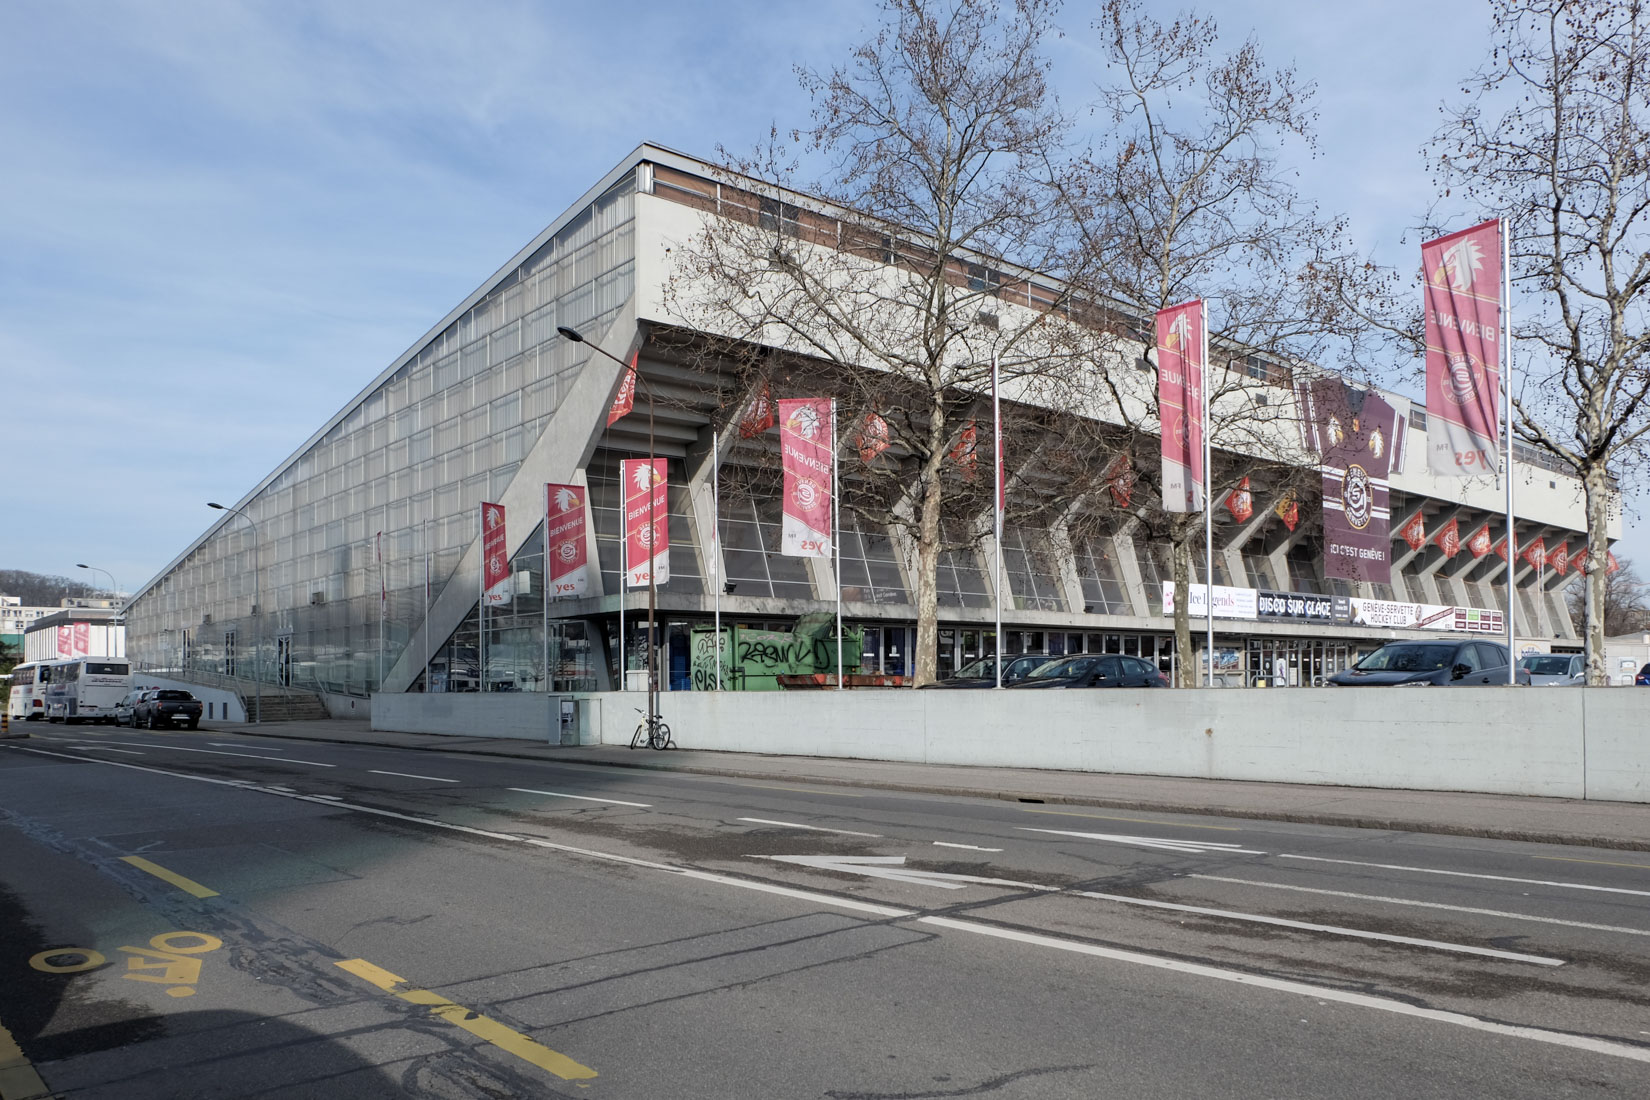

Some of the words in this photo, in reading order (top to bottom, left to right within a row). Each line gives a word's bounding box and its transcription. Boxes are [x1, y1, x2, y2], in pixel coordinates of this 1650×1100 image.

[550, 516, 584, 538] BIENVENUE
[555, 583, 576, 595] yes
[488, 594, 502, 603] yes
[1203, 592, 1235, 609] Lgends
[1259, 596, 1286, 613] DISCO
[1287, 598, 1305, 614] SUR
[1370, 613, 1393, 624] HOCKEY
[1393, 614, 1407, 625] CLUB
